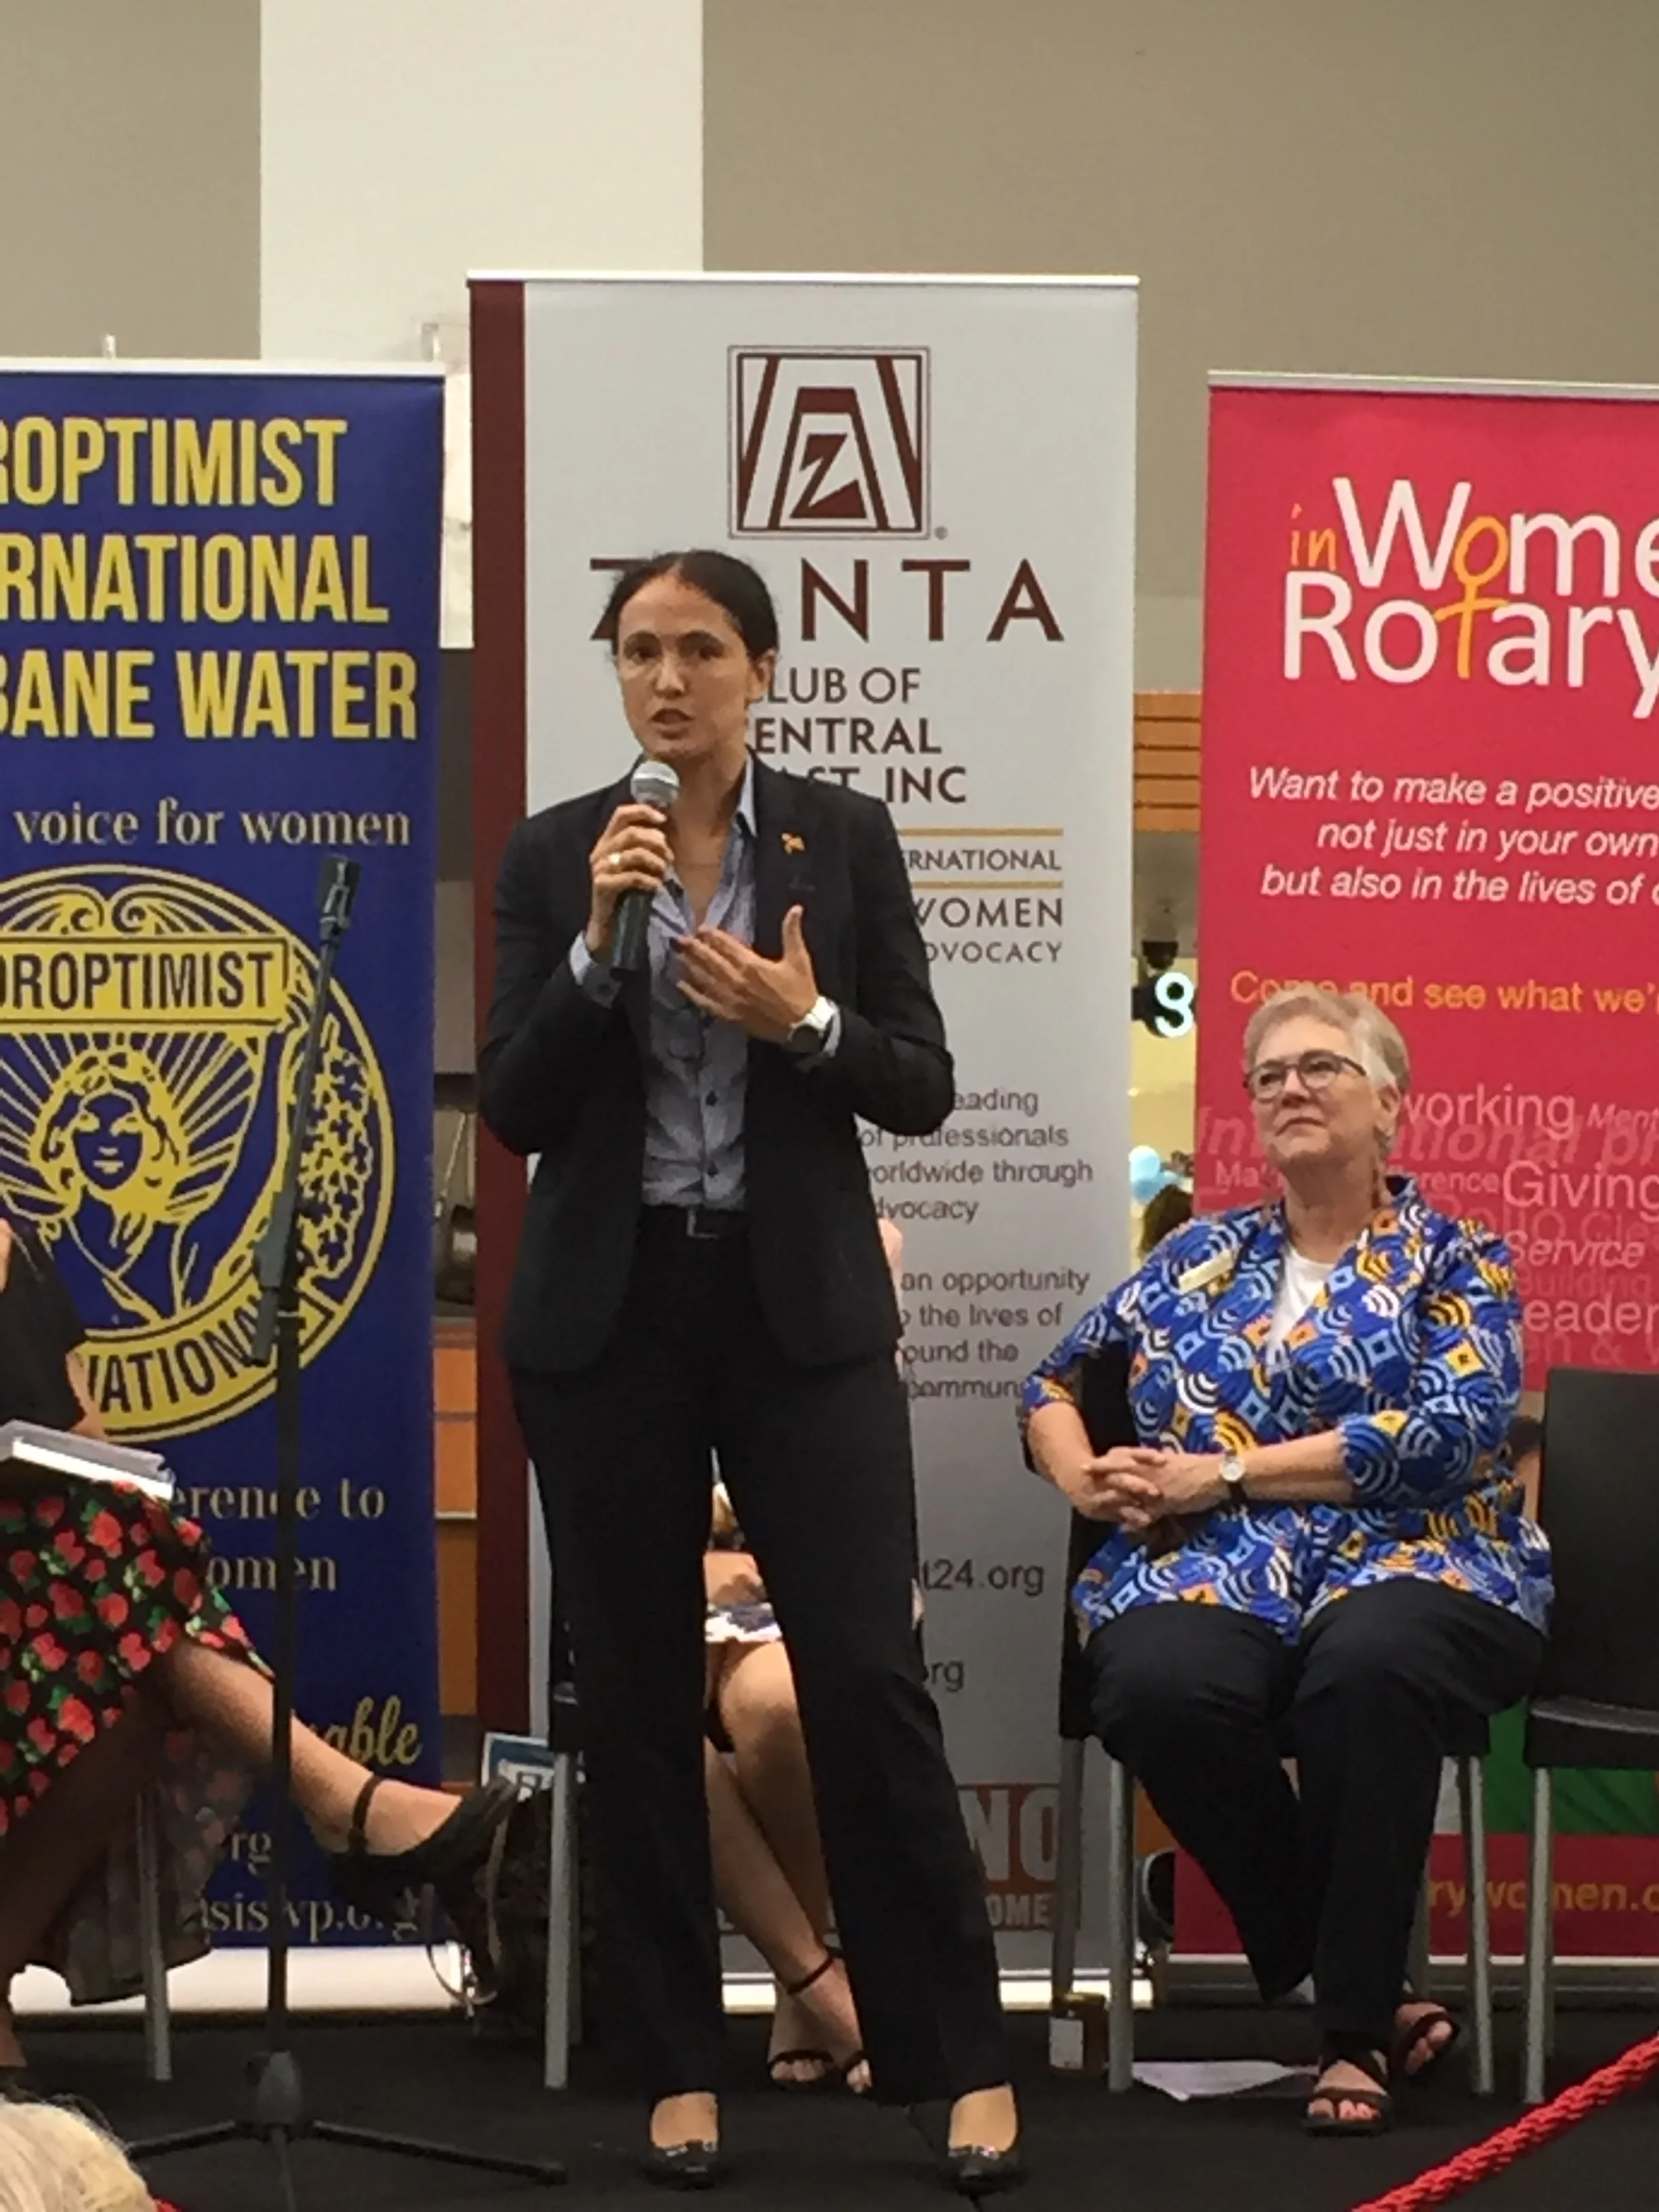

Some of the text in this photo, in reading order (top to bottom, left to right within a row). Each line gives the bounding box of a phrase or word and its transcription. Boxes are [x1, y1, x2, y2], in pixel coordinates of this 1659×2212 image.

[0, 417, 348, 506] OPTIMIST
[0, 533, 389, 623] RNATIONAL
[590, 557, 1065, 642] NTA
[1284, 570, 1659, 719] Rotary
[0, 649, 417, 739] ANE WATER
[754, 667, 920, 705] LUB OF
[754, 717, 943, 754] ENTRAL
[883, 766, 968, 804] INC
[1249, 766, 1659, 813] Want to make a positive
[14, 797, 411, 846] voice for women
[1317, 819, 1659, 861] not just in your own
[908, 849, 1062, 871] RNATIONAL
[1261, 864, 1320, 897] but
[1330, 867, 1401, 899] also
[1411, 868, 1443, 899] in
[1452, 872, 1509, 901] the
[1518, 872, 1595, 904] lives
[1605, 873, 1648, 905] of
[925, 940, 1063, 964] DVOCACY
[0, 951, 274, 1010] ROPTIMIST
[1349, 977, 1414, 1007] and
[1423, 981, 1487, 1010] see
[1497, 980, 1582, 1013] what
[954, 1088, 1039, 1117] eading
[869, 1160, 1094, 1187] orldwide through
[1503, 1229, 1645, 1269] Service
[902, 1268, 1090, 1296] an opportunity
[919, 1303, 961, 1327] the
[969, 1303, 1029, 1327] lives
[1036, 1301, 1063, 1327] of
[1523, 1292, 1659, 1335] eader
[903, 1339, 1019, 1364] ound the
[340, 1477, 385, 1520] to
[922, 1559, 1045, 1598] t24.org
